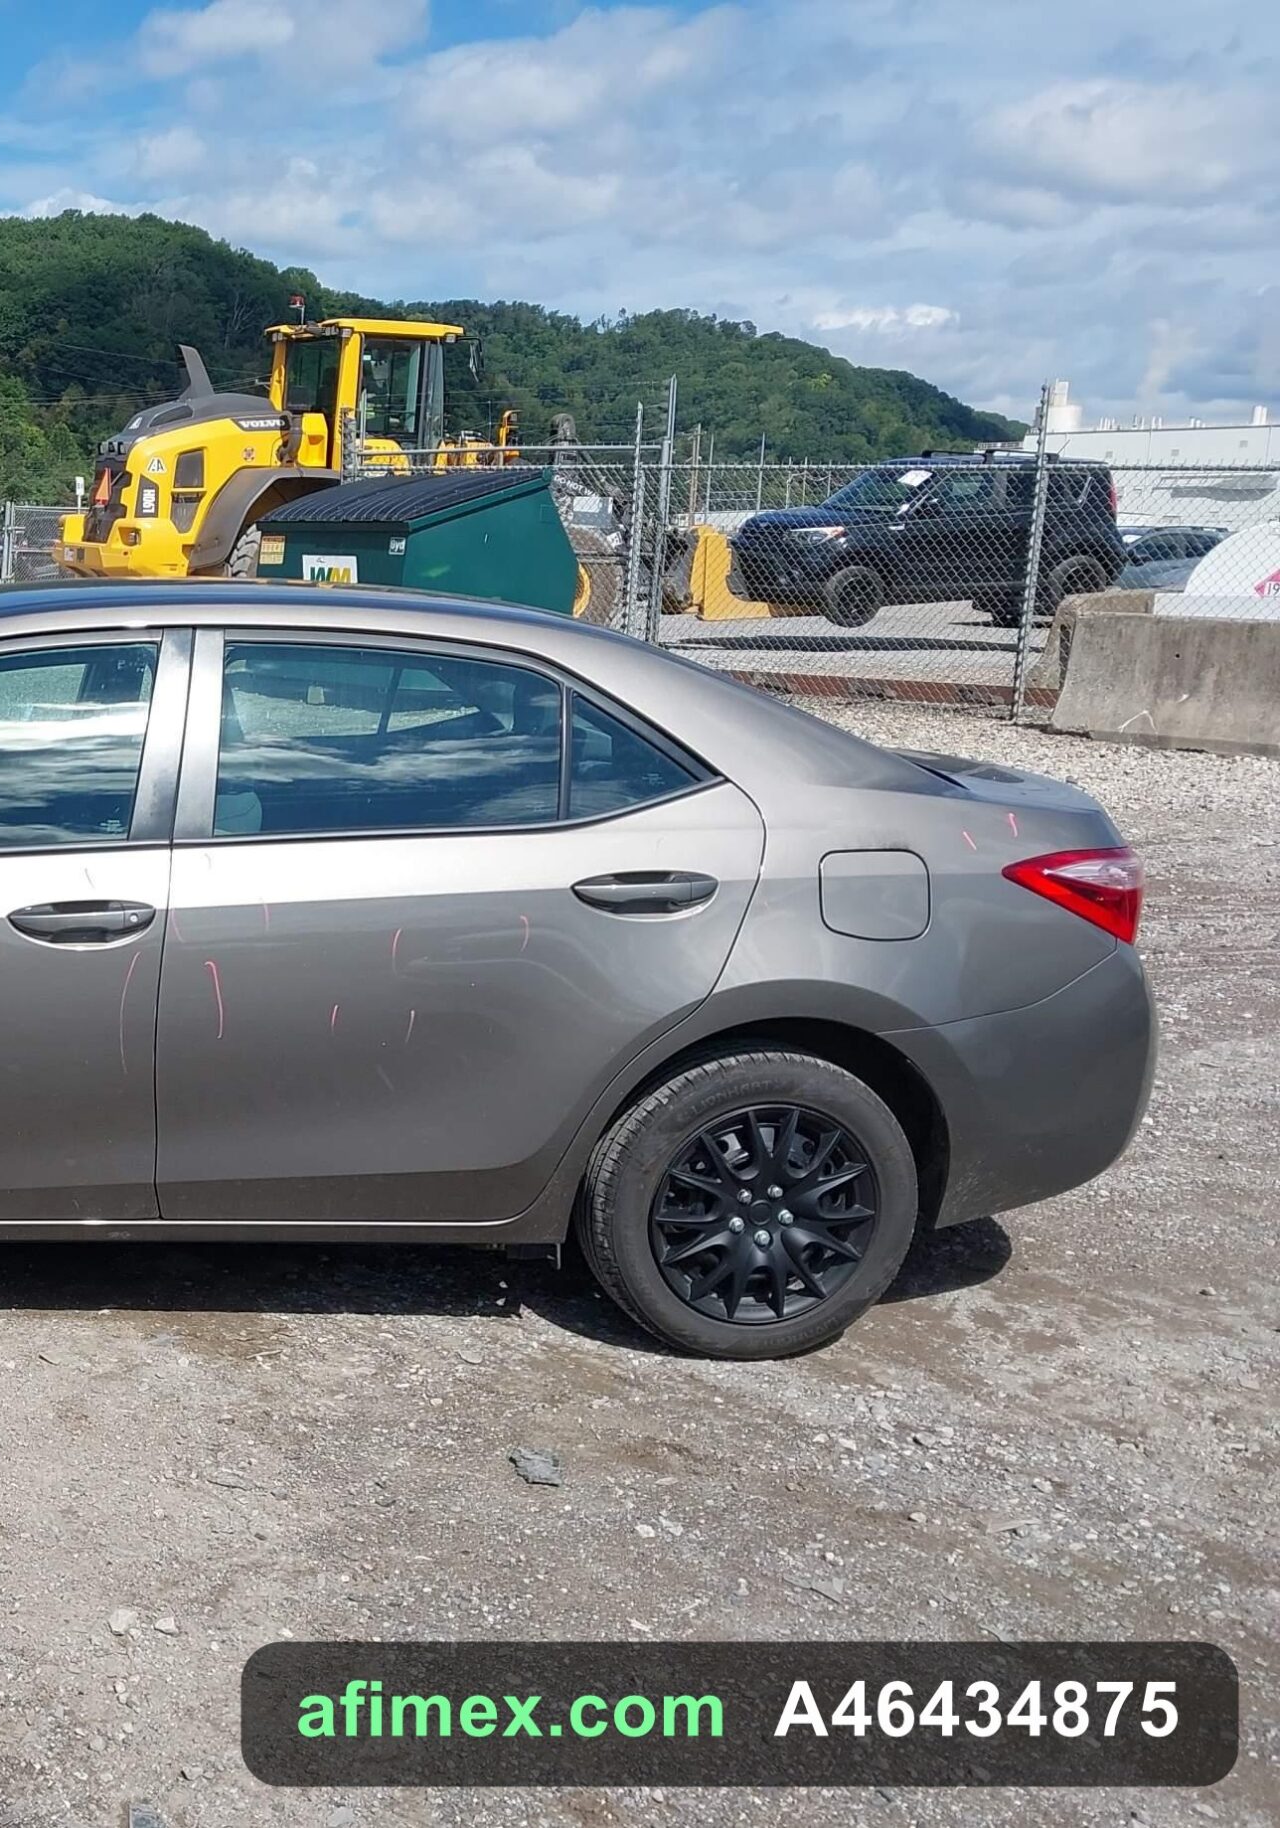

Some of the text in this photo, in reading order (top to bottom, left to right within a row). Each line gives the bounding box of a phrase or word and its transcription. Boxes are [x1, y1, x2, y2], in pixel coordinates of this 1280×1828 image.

[238, 419, 286, 428] VOLVO
[142, 489, 156, 514] L90H
[310, 566, 351, 583] WM
